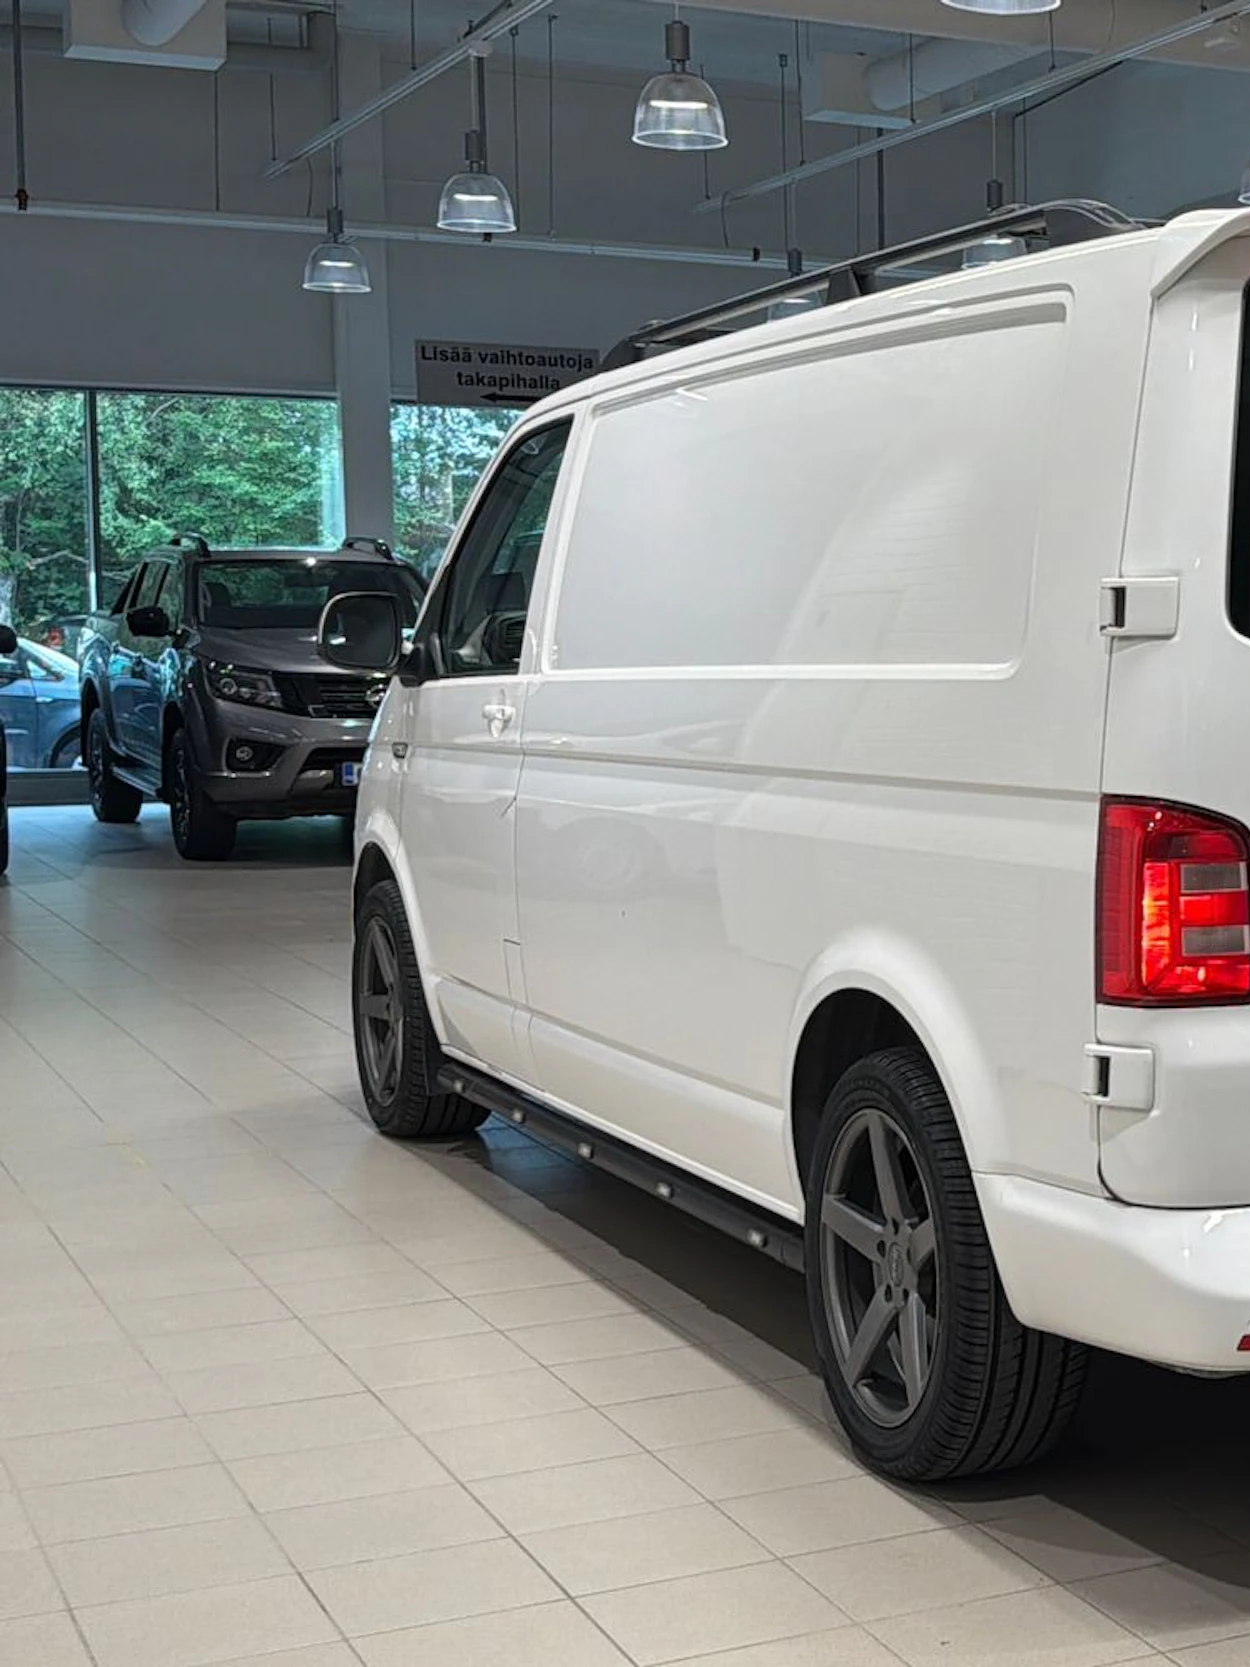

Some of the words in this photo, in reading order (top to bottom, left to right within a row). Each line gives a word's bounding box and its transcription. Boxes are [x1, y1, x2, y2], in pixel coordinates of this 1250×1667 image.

[420, 346, 472, 363] Lisää
[478, 349, 594, 372] vaihtoautoja
[456, 371, 561, 391] takapihalla
